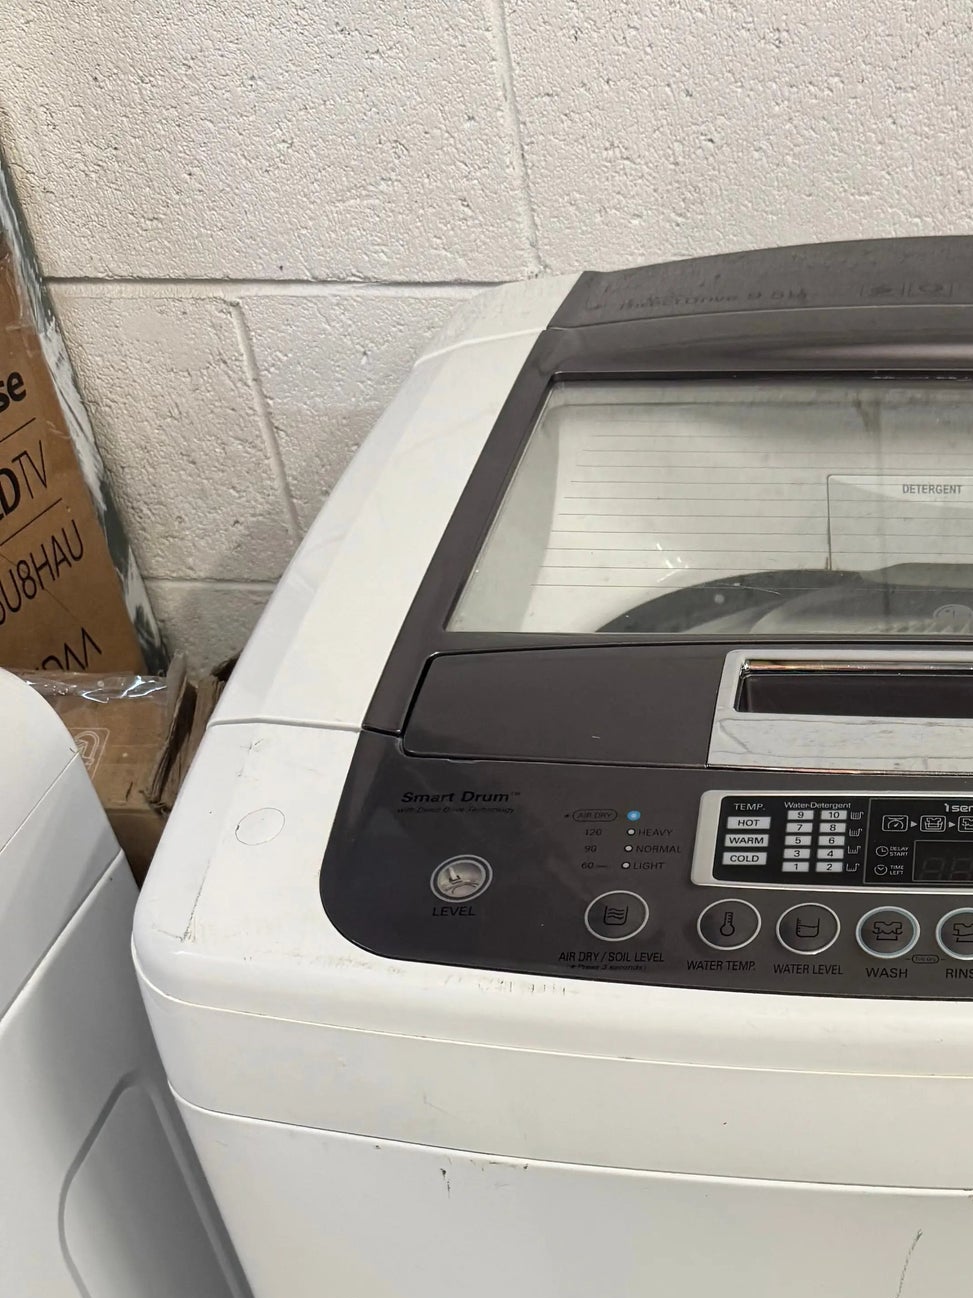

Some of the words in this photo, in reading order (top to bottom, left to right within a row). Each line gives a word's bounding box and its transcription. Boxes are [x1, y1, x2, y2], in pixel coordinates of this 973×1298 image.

[0, 440, 47, 520] DTV
[902, 484, 962, 495] DETERGENT
[401, 791, 455, 803] Smart
[734, 803, 767, 811] TEMP.
[797, 811, 804, 819] 9
[829, 811, 840, 819] 10
[737, 819, 760, 827] HOT
[585, 828, 602, 836] 120
[639, 828, 673, 836] HEAVY
[729, 836, 764, 844] WARM
[585, 845, 597, 853] 90
[636, 845, 681, 853] NORMAL
[729, 855, 760, 863] COLD
[581, 862, 594, 870] 60
[633, 862, 666, 870] LIGHT
[826, 863, 833, 871] 2
[432, 906, 476, 917] LEVEL
[559, 952, 576, 961] AIR
[579, 952, 600, 962] DRY
[608, 952, 630, 962] SOIL
[634, 952, 665, 963] LEVEL
[686, 960, 725, 971] WATER
[773, 963, 810, 975] WATER
[812, 964, 844, 976] LEVEL
[865, 968, 908, 979] WASH
